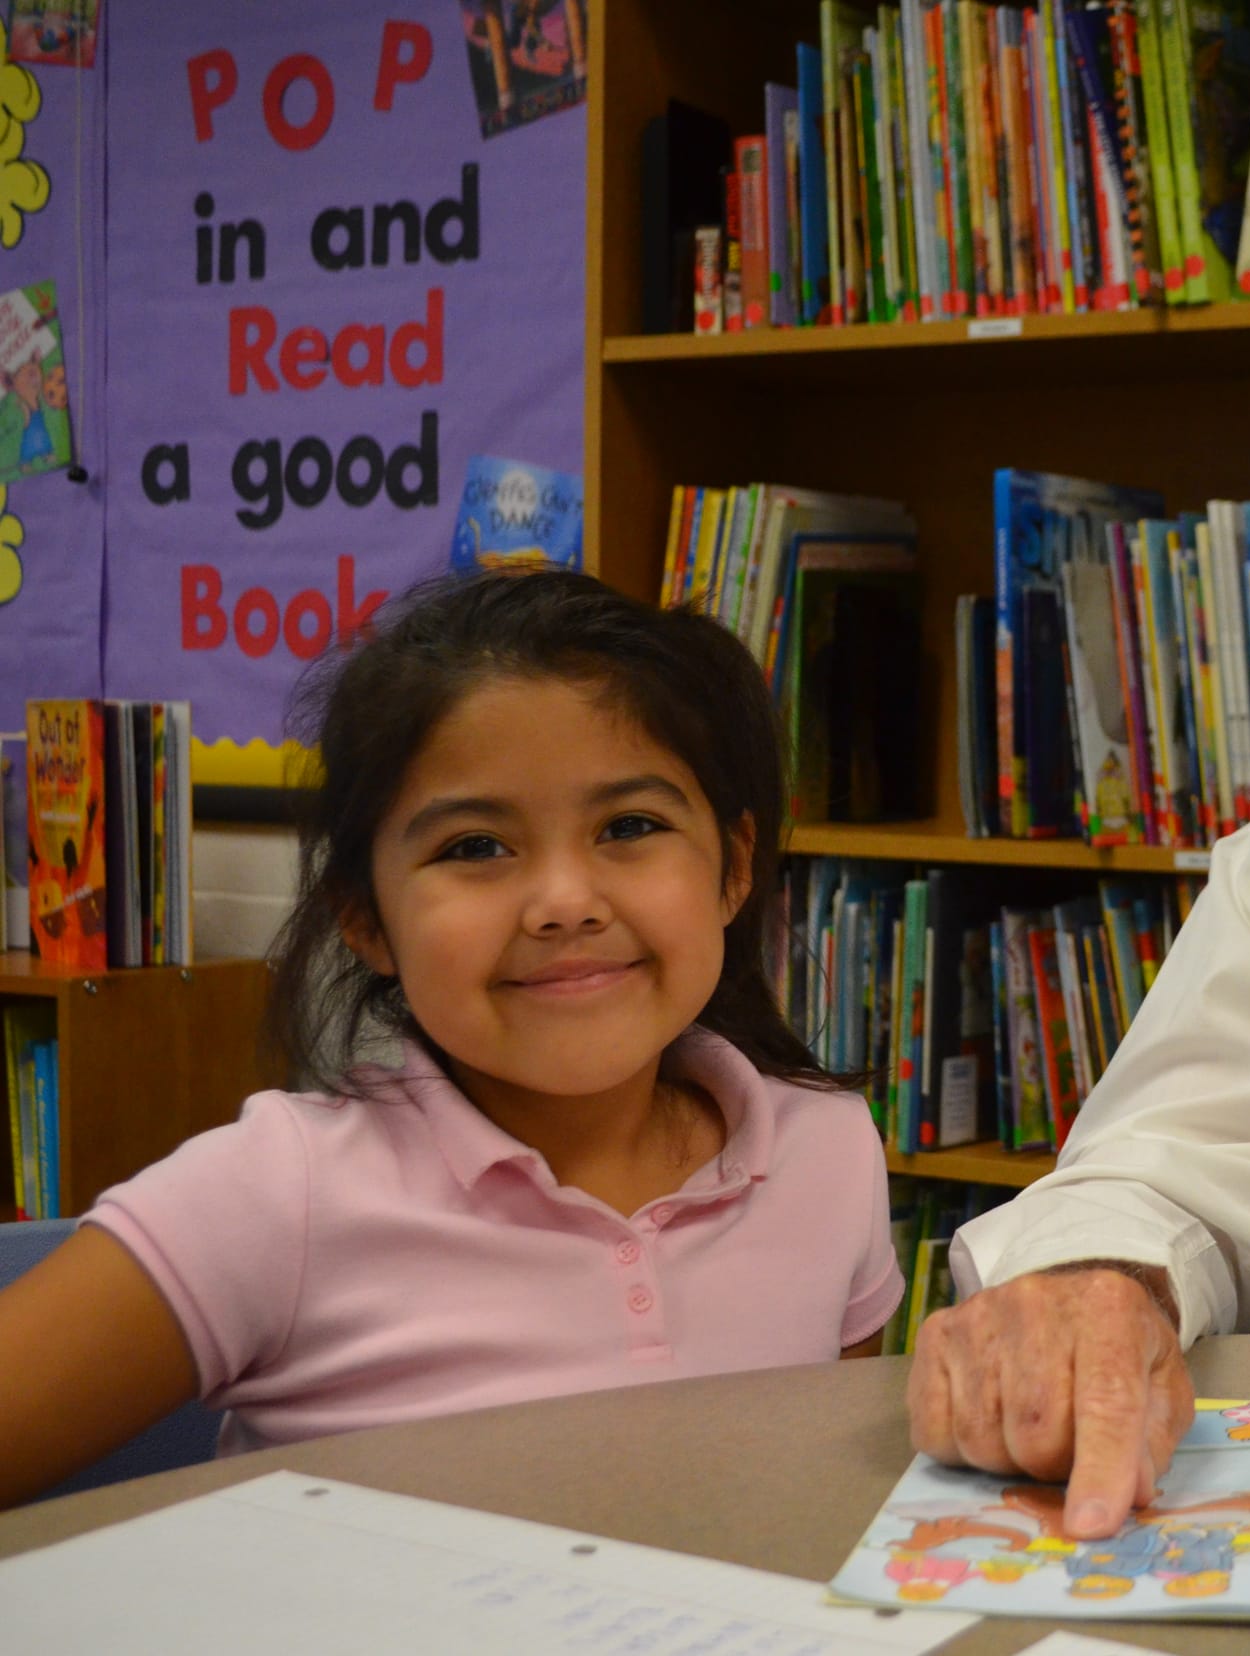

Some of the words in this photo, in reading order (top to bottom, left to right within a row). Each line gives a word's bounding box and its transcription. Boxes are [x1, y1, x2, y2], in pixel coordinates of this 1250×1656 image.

[194, 191, 266, 285] in
[310, 162, 480, 271] and
[228, 286, 444, 396] Read
[141, 442, 190, 504] a
[231, 409, 439, 530] good
[180, 555, 390, 660] Book
